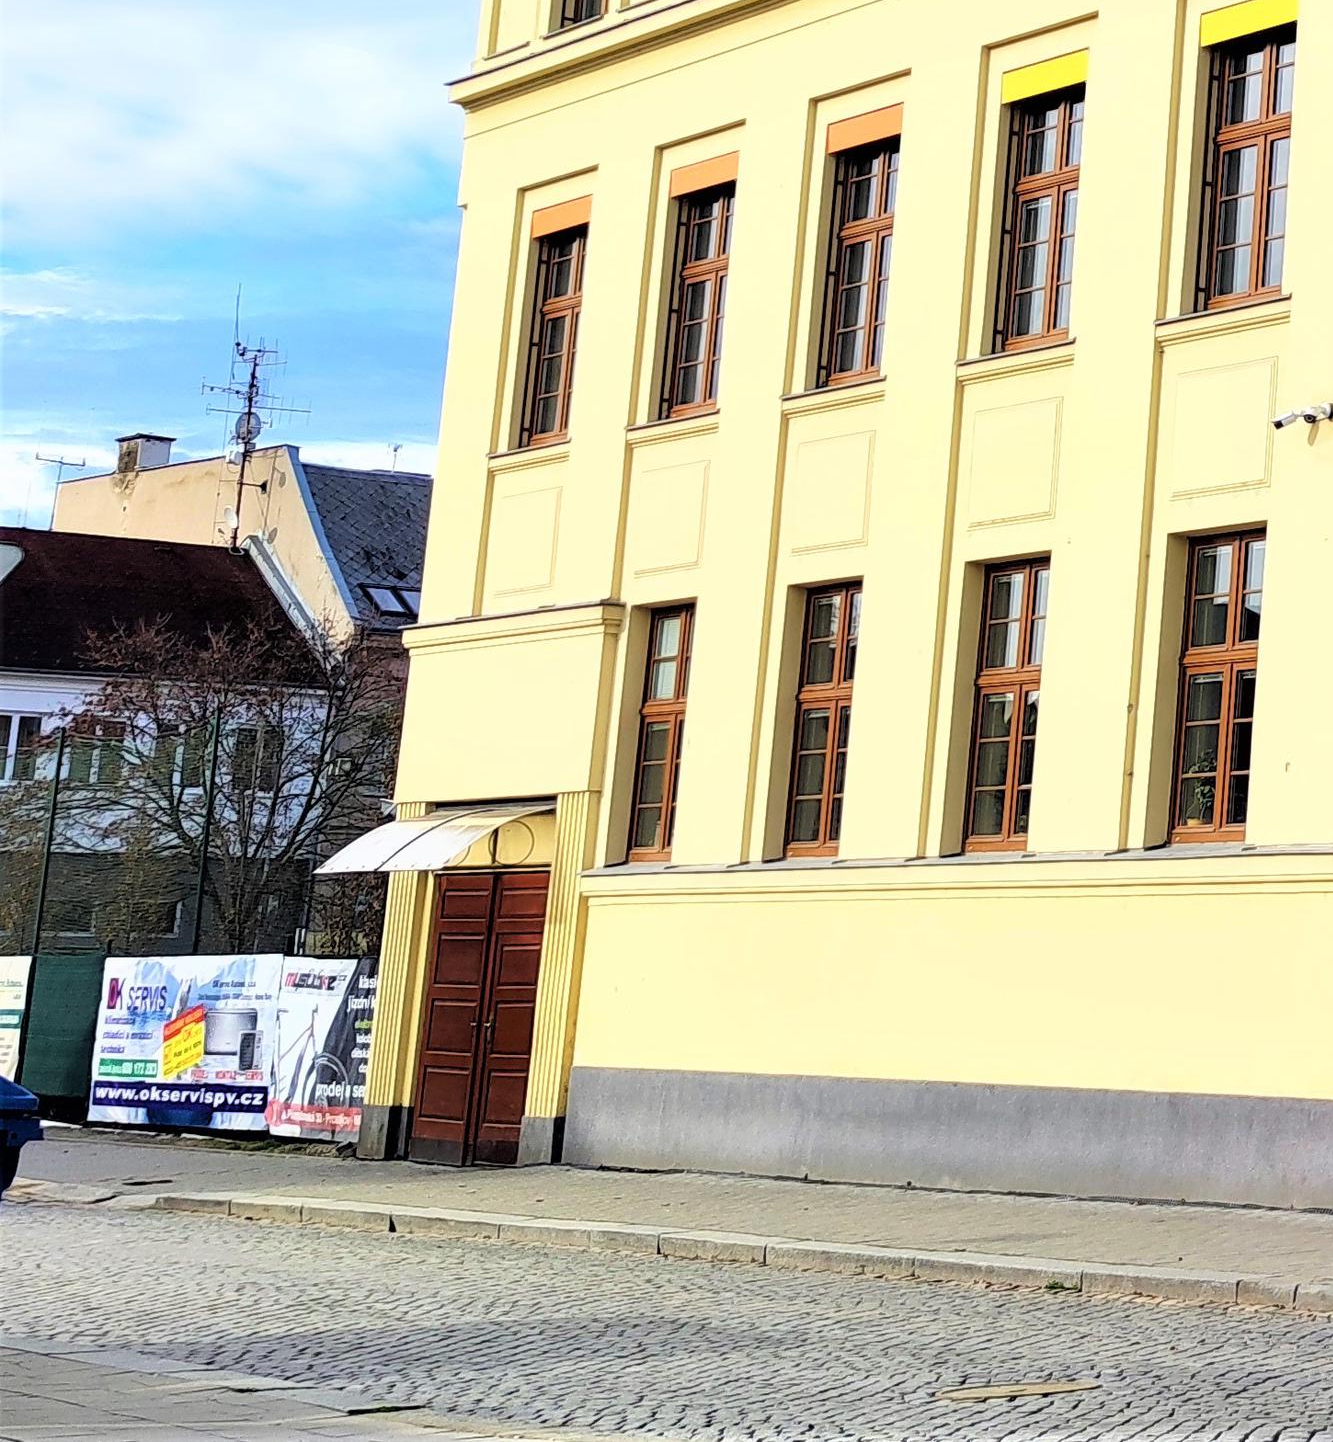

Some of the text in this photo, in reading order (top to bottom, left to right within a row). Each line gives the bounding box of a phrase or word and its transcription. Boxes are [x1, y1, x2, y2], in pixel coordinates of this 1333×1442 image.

[106, 977, 168, 1012] OK SERVIS
[95, 1085, 264, 1107] www.okservispv.cz
